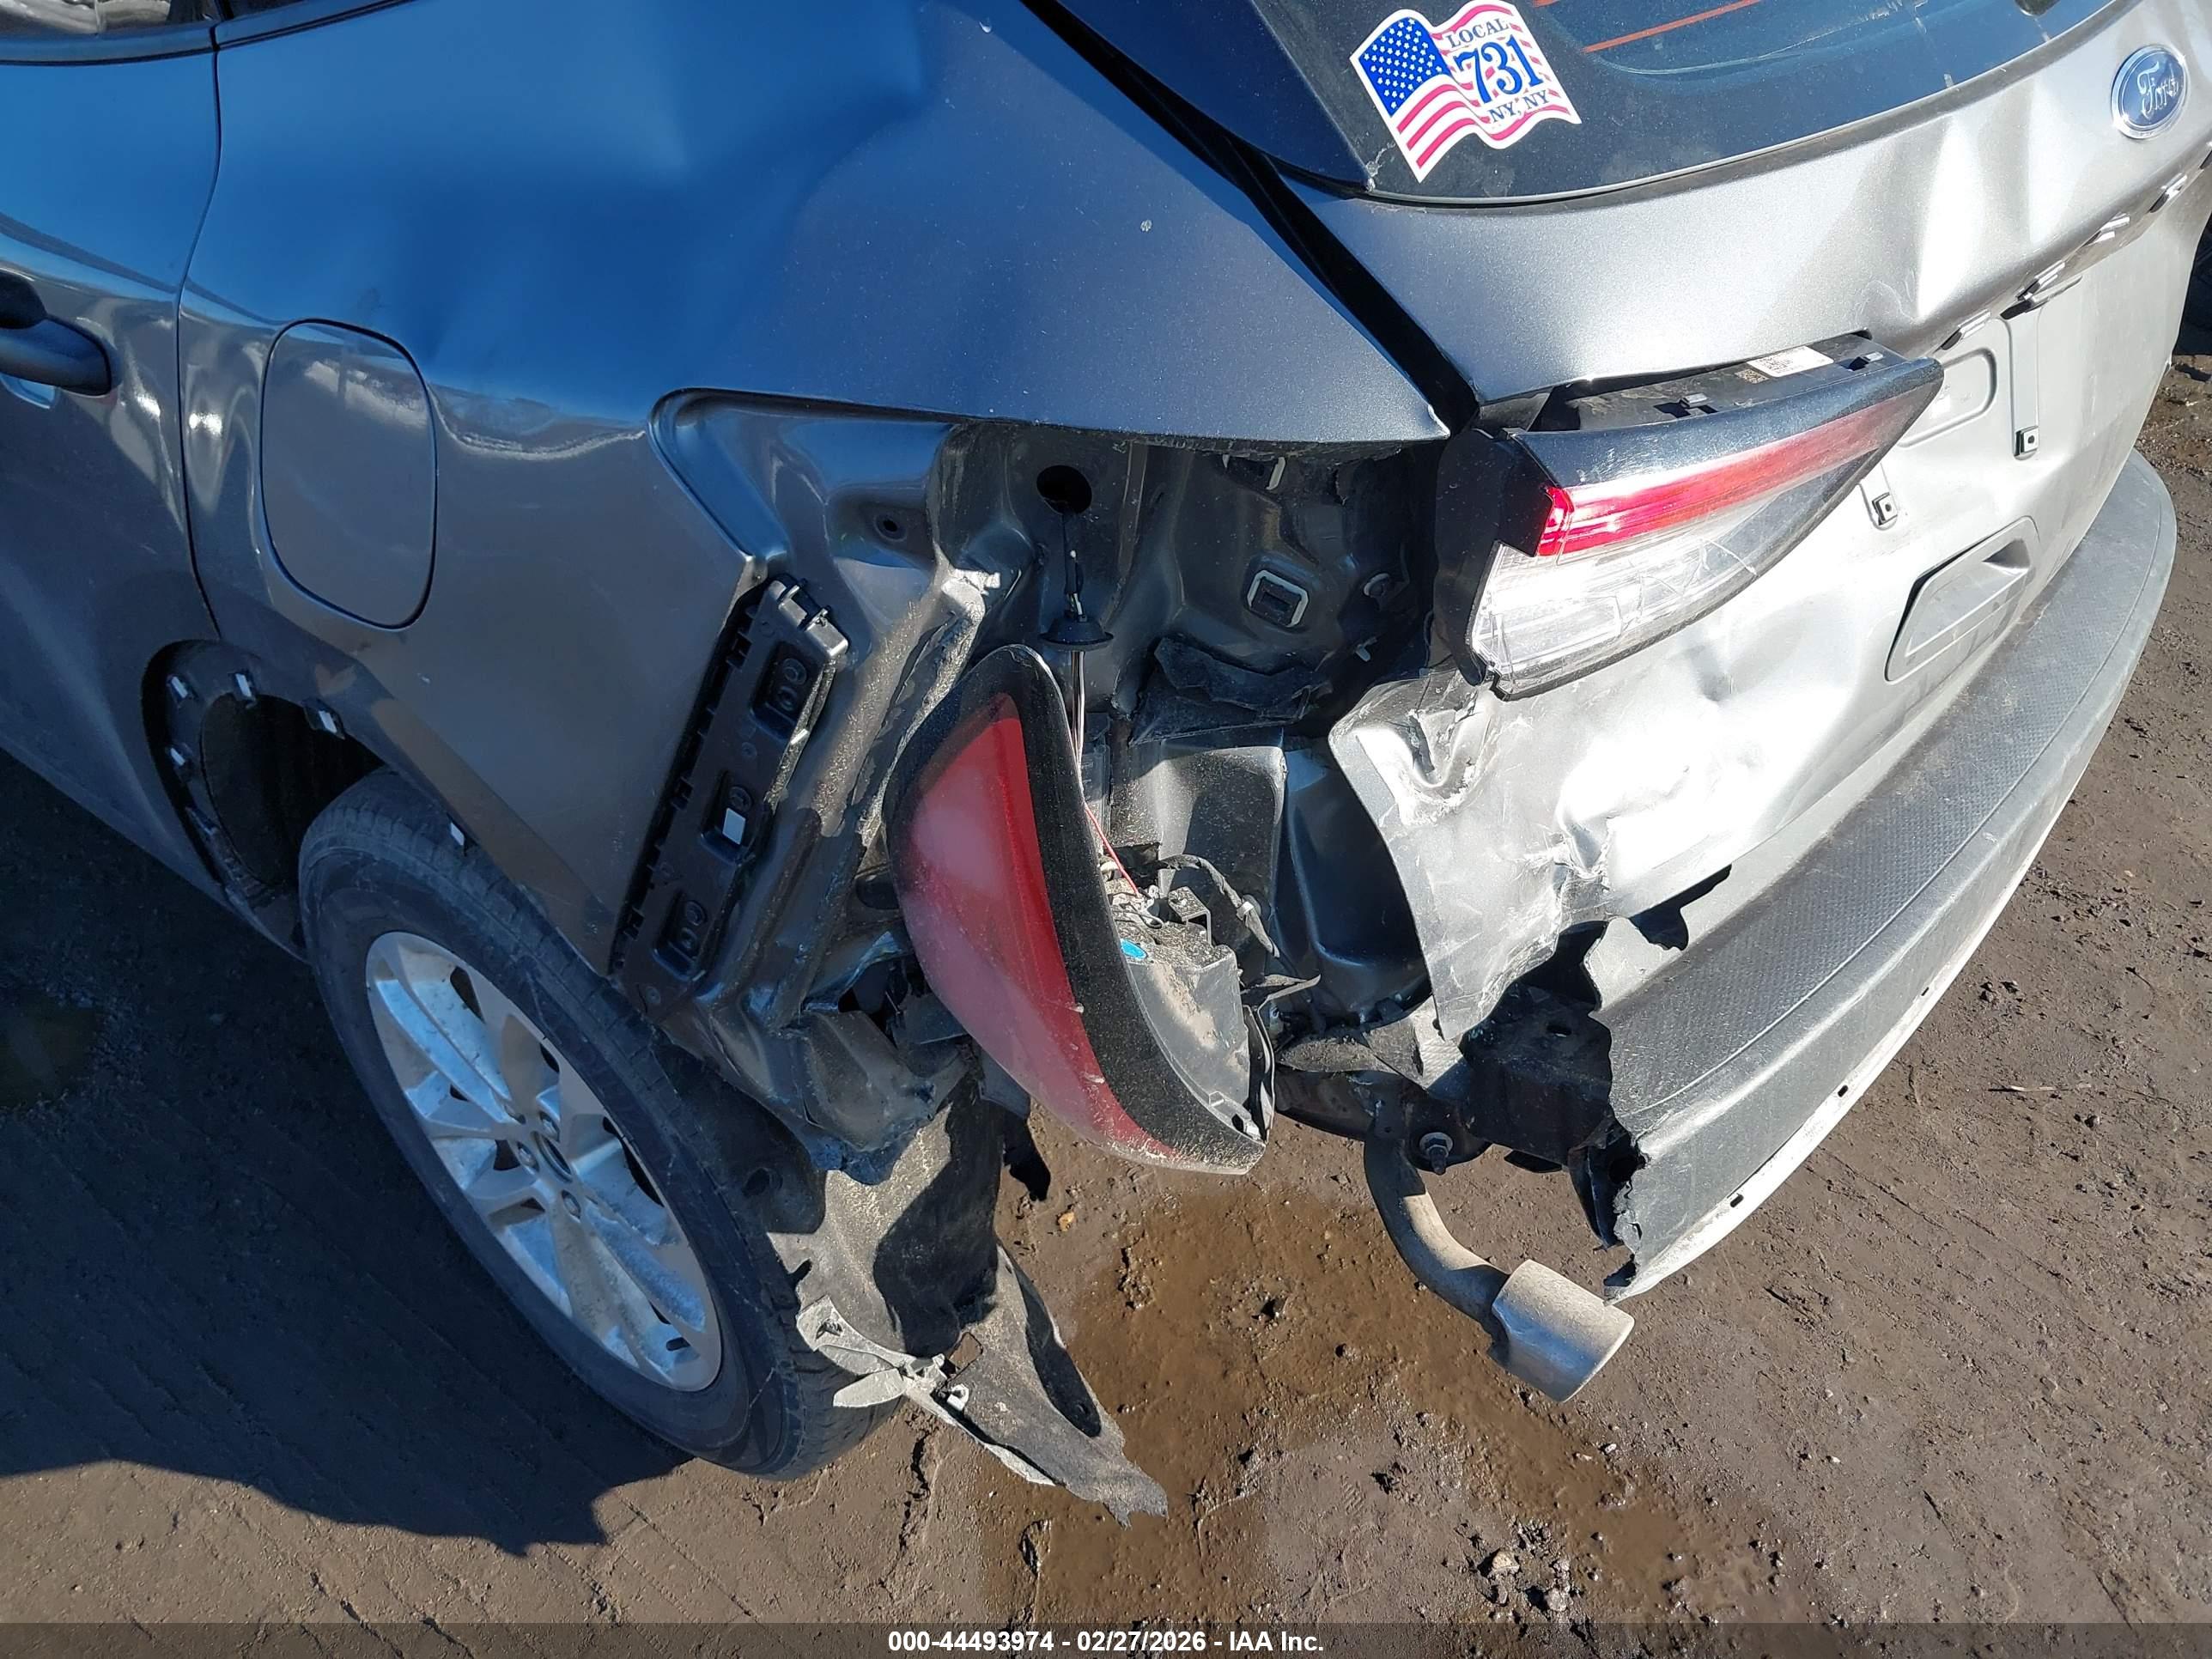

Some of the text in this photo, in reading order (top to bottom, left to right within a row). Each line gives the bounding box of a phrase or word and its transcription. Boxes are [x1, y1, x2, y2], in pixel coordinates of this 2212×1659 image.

[1446, 18, 1509, 48] LOCAL
[1453, 34, 1544, 104] 731
[2136, 61, 2179, 120] Ford
[1488, 89, 1550, 124] NY, NY
